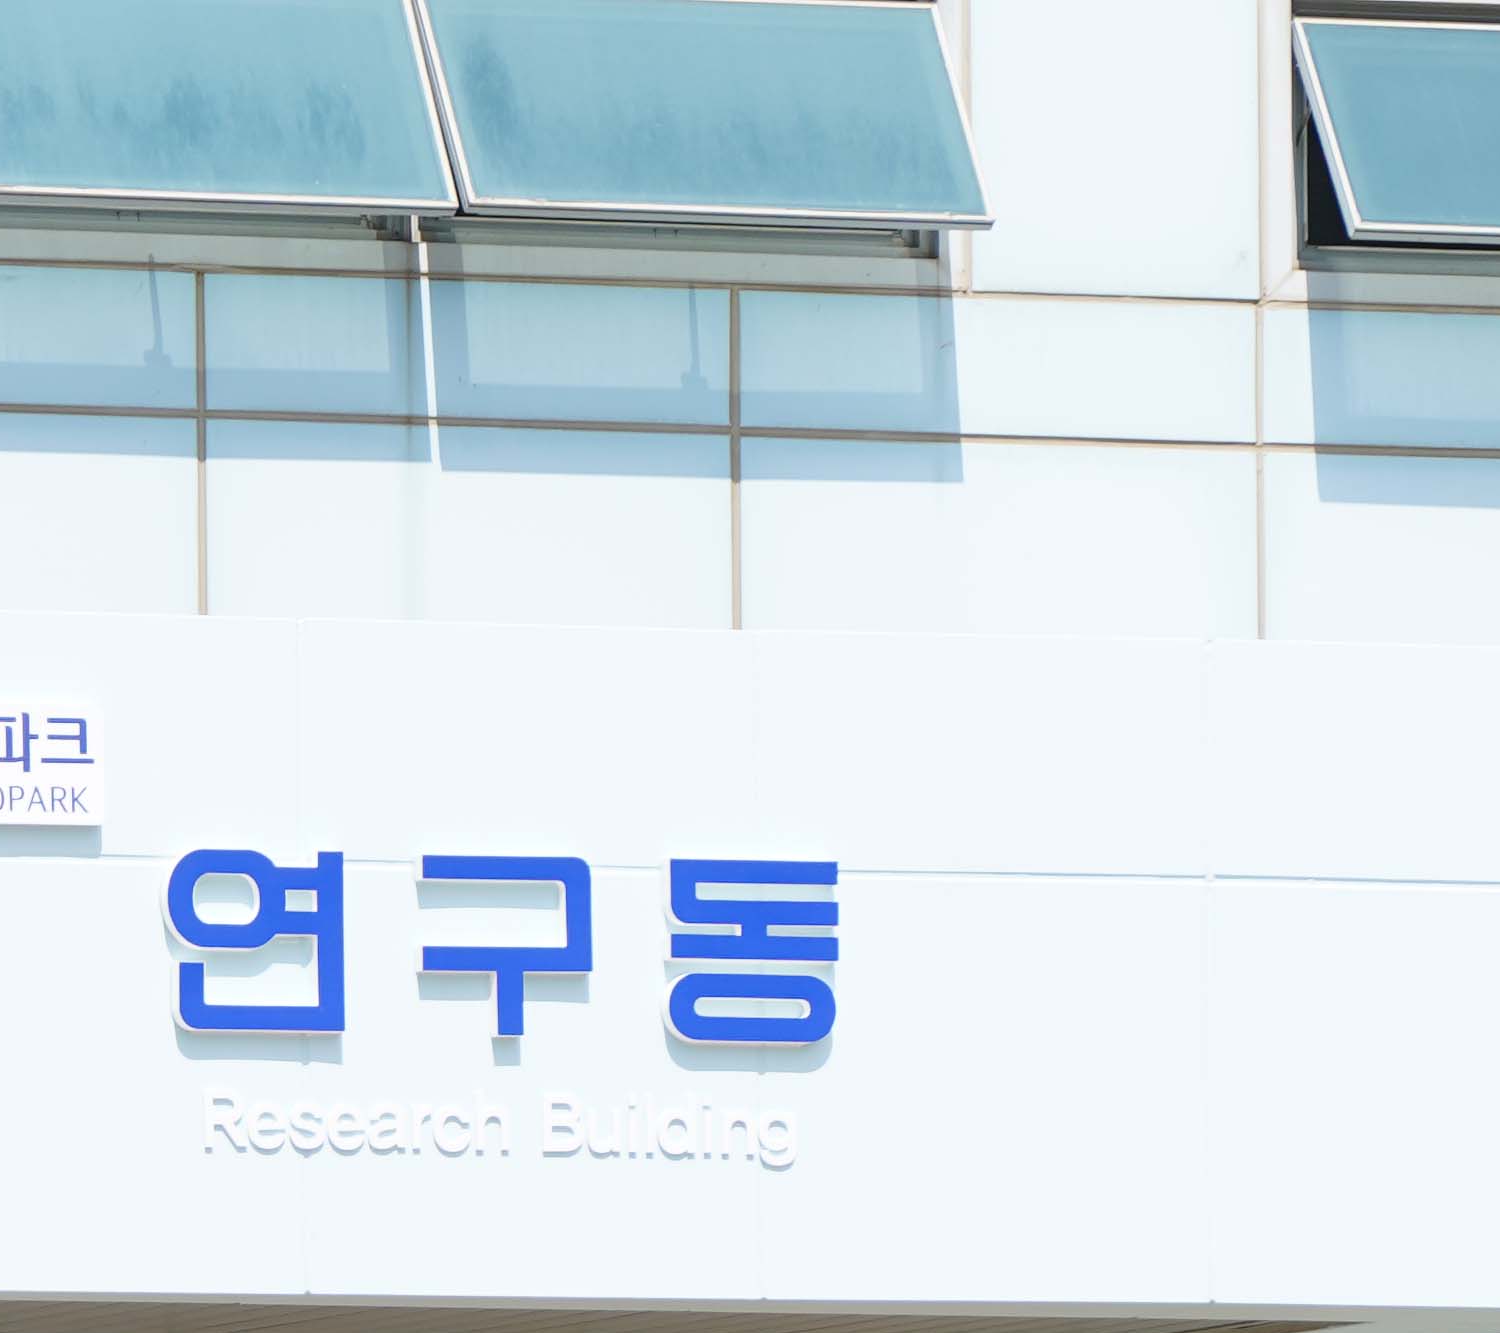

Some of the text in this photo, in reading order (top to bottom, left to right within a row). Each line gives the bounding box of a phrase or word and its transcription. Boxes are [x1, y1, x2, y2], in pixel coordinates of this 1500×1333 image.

[166, 848, 840, 1045] 연구동
[202, 1092, 799, 1172] Research Building
